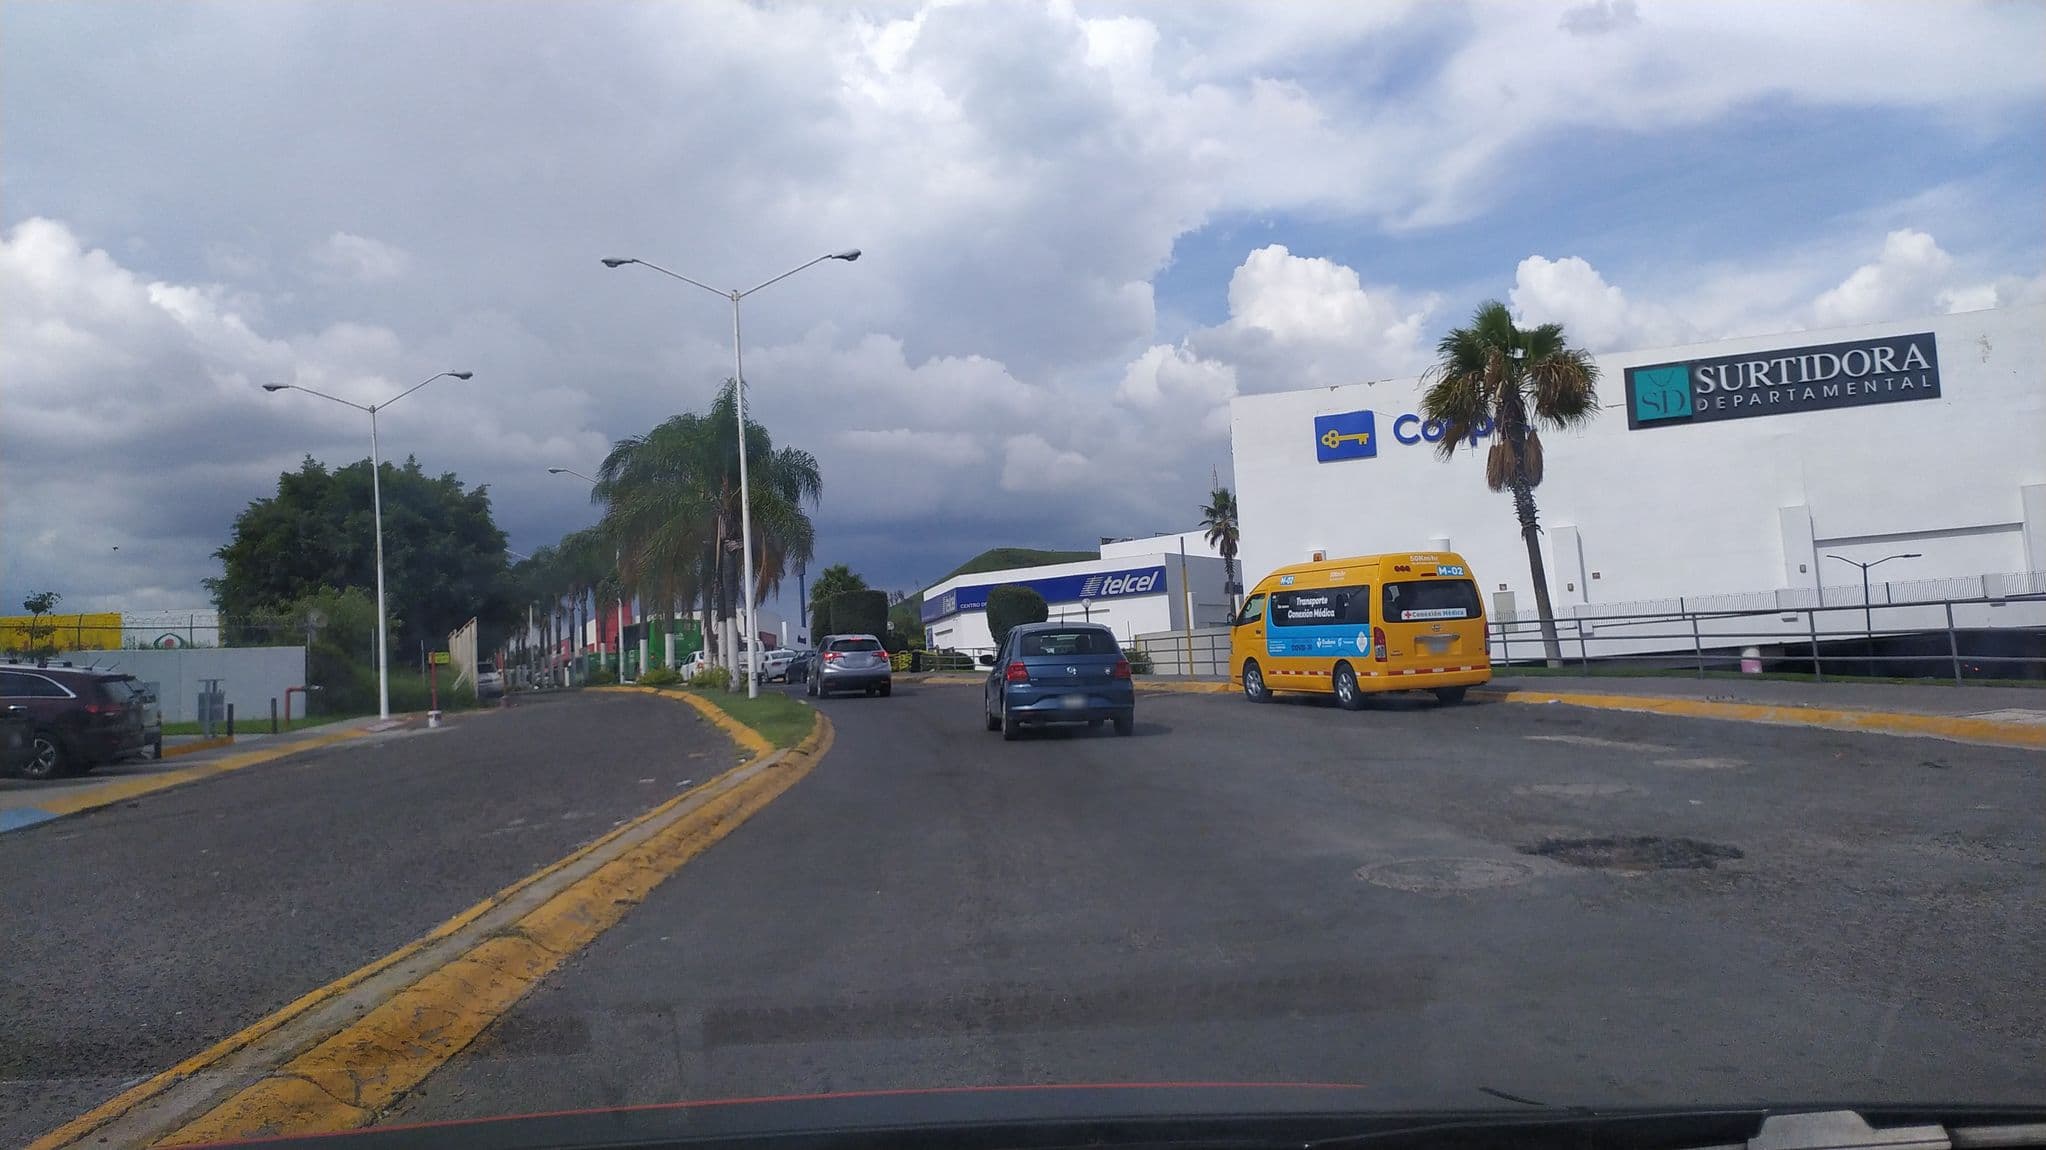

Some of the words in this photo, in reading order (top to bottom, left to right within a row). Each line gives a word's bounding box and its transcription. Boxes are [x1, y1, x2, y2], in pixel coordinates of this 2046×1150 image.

[1696, 343, 1931, 394] SURTIDORA
[1696, 374, 1931, 411] DEPARTAMENTAL
[1438, 566, 1463, 575] M-02
[1101, 571, 1159, 595] telcel
[1296, 597, 1328, 607] Transporte
[1288, 609, 1313, 618] Conexión
[1314, 608, 1335, 617] Médica
[1412, 610, 1441, 618] Conexión
